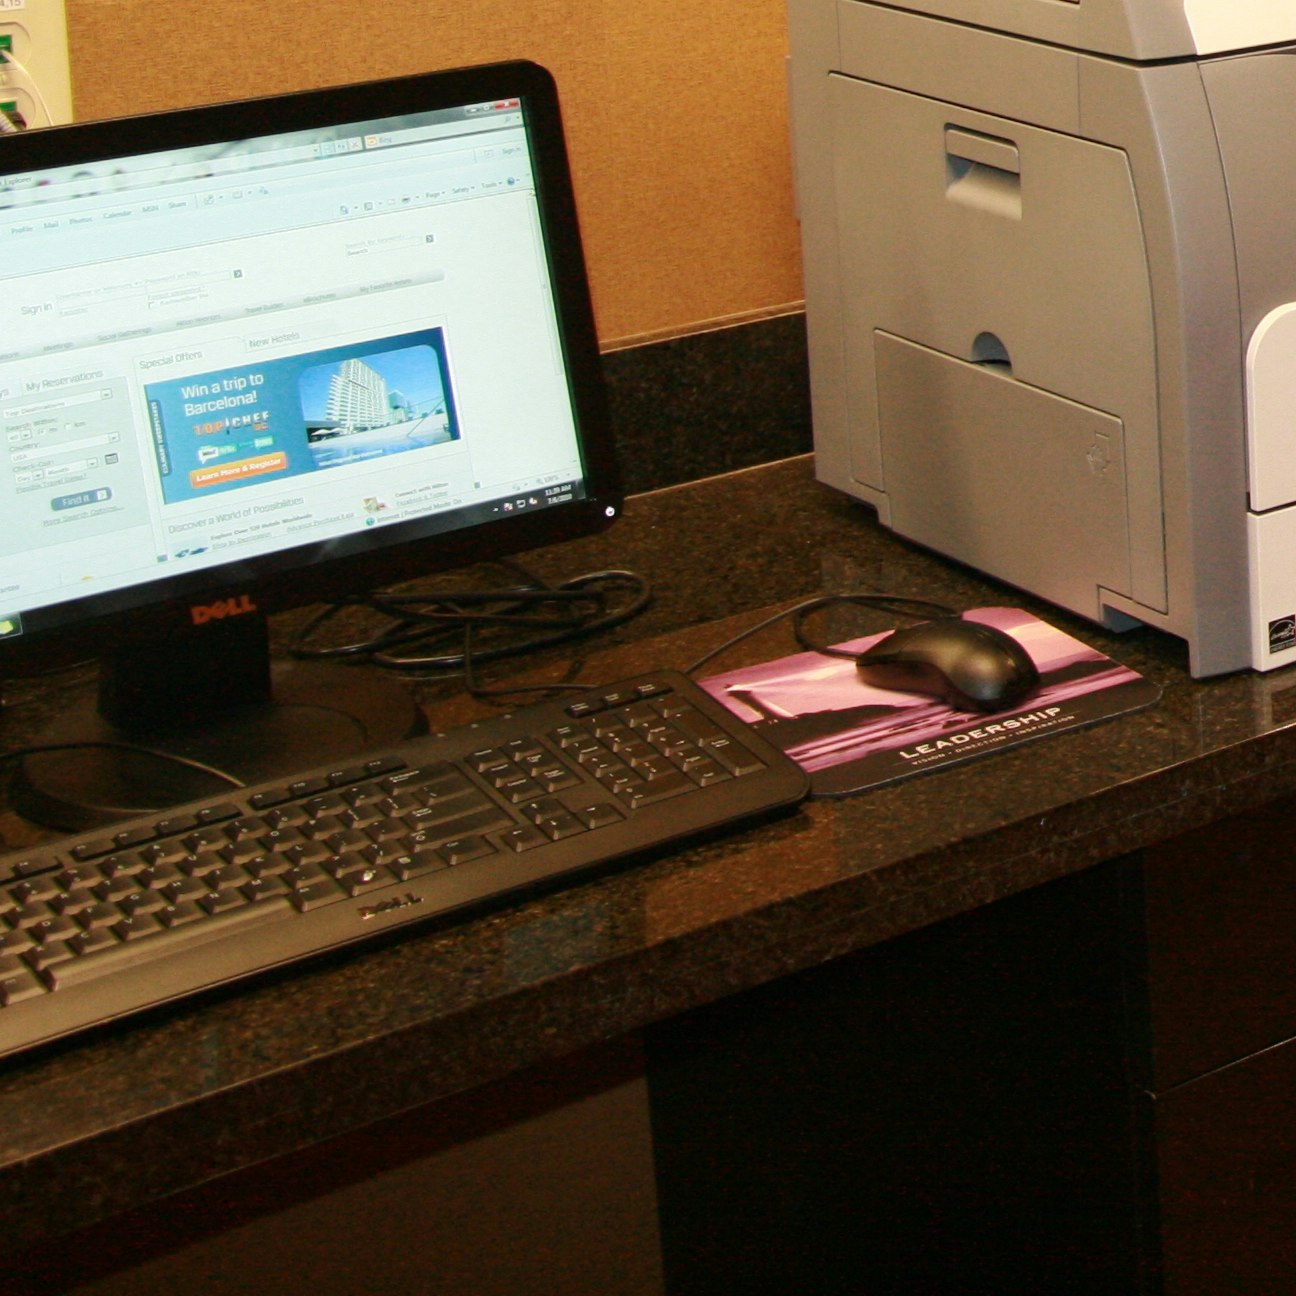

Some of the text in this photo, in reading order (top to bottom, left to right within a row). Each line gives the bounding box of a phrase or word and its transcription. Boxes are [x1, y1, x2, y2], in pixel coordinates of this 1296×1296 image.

[21, 304, 42, 316] Sign
[249, 331, 300, 348] New Hotels
[139, 350, 203, 370] Special Offers
[26, 369, 104, 392] My Reservations
[181, 373, 264, 400] Win a trip to
[184, 391, 258, 417] Barcelona!
[194, 411, 270, 435] TOP CHEF
[196, 472, 219, 482] Learn
[220, 467, 241, 477] More
[249, 458, 281, 471] Register
[62, 495, 82, 506] Find
[168, 518, 208, 535] Discover
[216, 510, 241, 524] World
[242, 508, 252, 517] of
[253, 496, 304, 515] Possibilities
[190, 594, 257, 626] DELL
[899, 706, 1061, 759] LEADERSHIP
[911, 714, 1076, 766] VISION DIRECTION INSPIRATION
